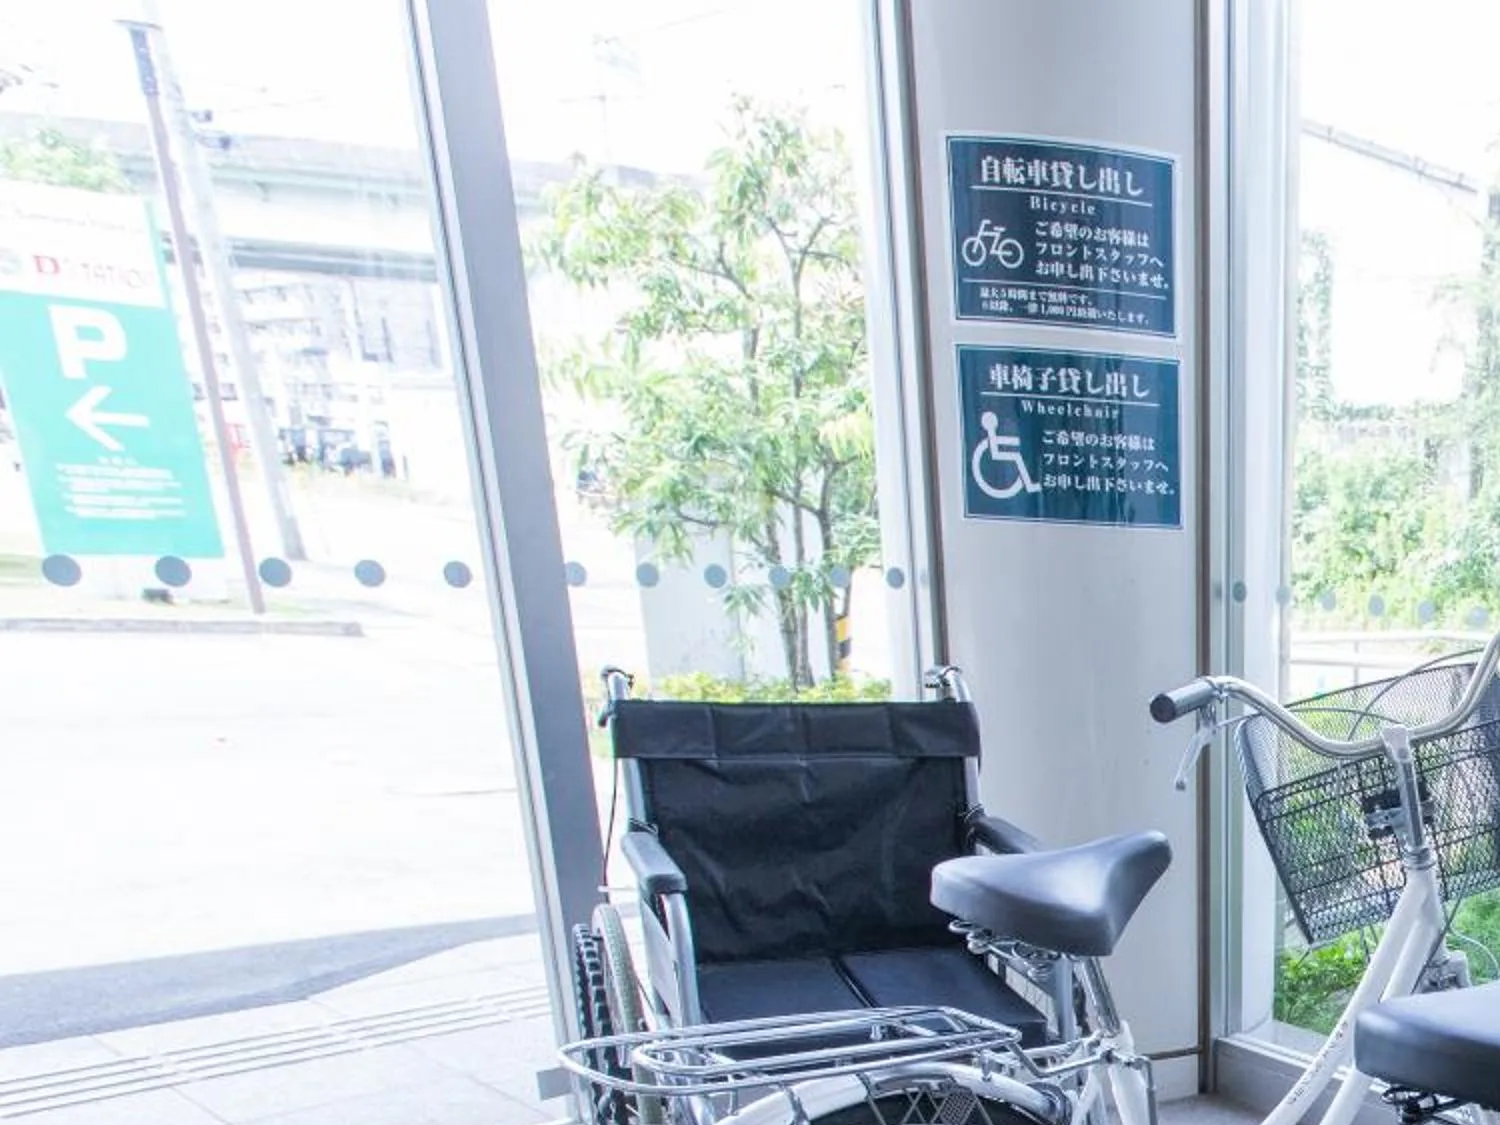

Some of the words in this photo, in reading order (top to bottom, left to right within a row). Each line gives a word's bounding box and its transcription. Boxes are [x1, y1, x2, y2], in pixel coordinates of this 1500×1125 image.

[980, 154, 1143, 197] 自転車貸し出し
[1029, 195, 1097, 216] Bicycle
[1034, 221, 1150, 248] ご希望のお客様は
[1035, 241, 1165, 268] フロントスタッフへ
[47, 304, 128, 379] P
[989, 363, 1150, 399] 車椅子貸し出し
[1020, 400, 1121, 419] Wheelchair
[1041, 429, 1155, 452] ご希望のお客様は
[1042, 452, 1170, 473] フロントスタッフへ
